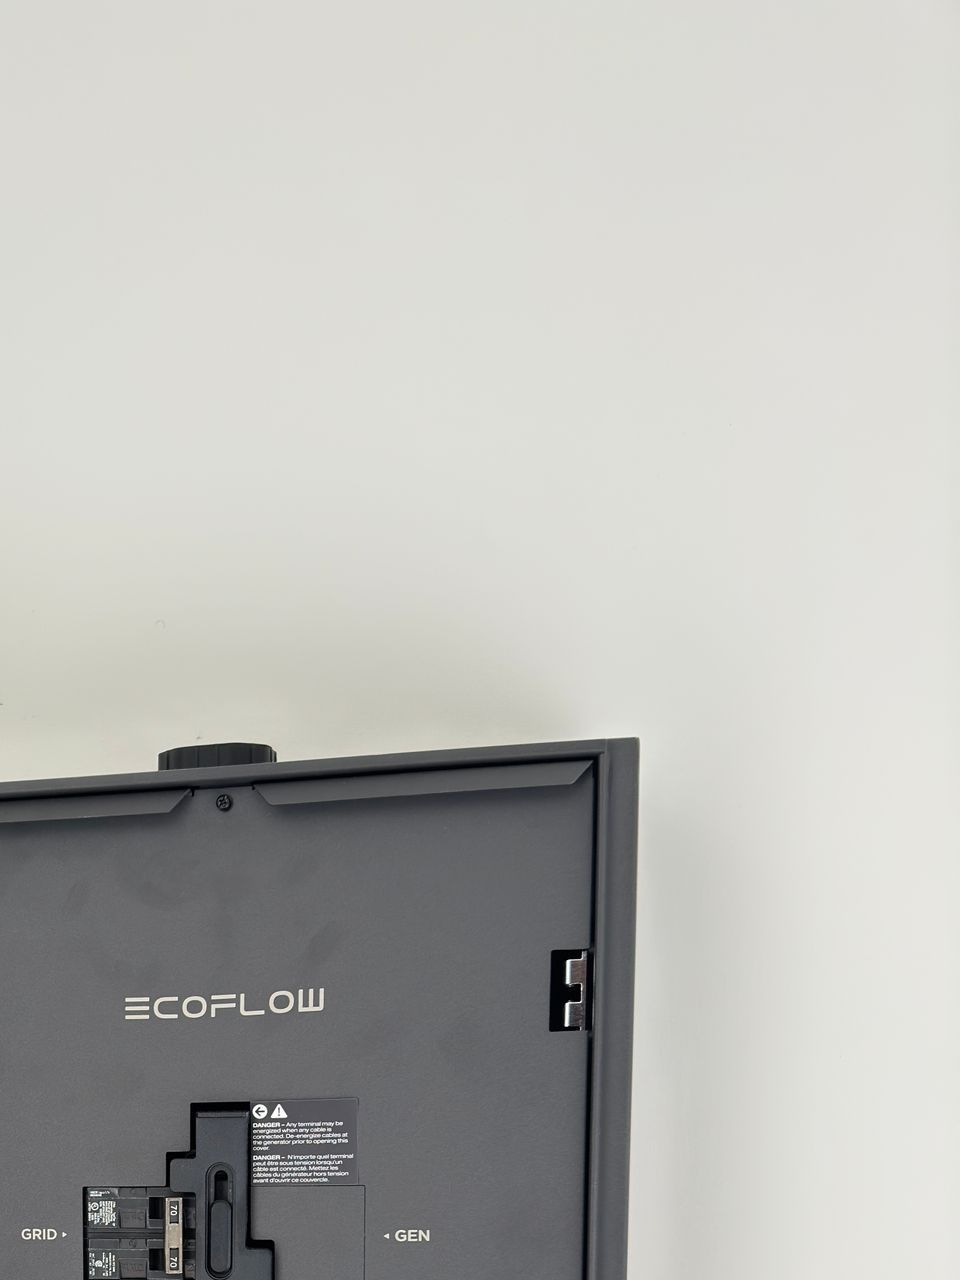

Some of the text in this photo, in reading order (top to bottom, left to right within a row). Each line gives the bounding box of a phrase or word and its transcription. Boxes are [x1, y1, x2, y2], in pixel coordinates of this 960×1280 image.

[124, 987, 325, 1021] ECOFLOW
[170, 1205, 178, 1216] 70
[21, 1228, 58, 1240] GRID
[394, 1229, 430, 1242] GEN
[170, 1257, 178, 1268] 70
